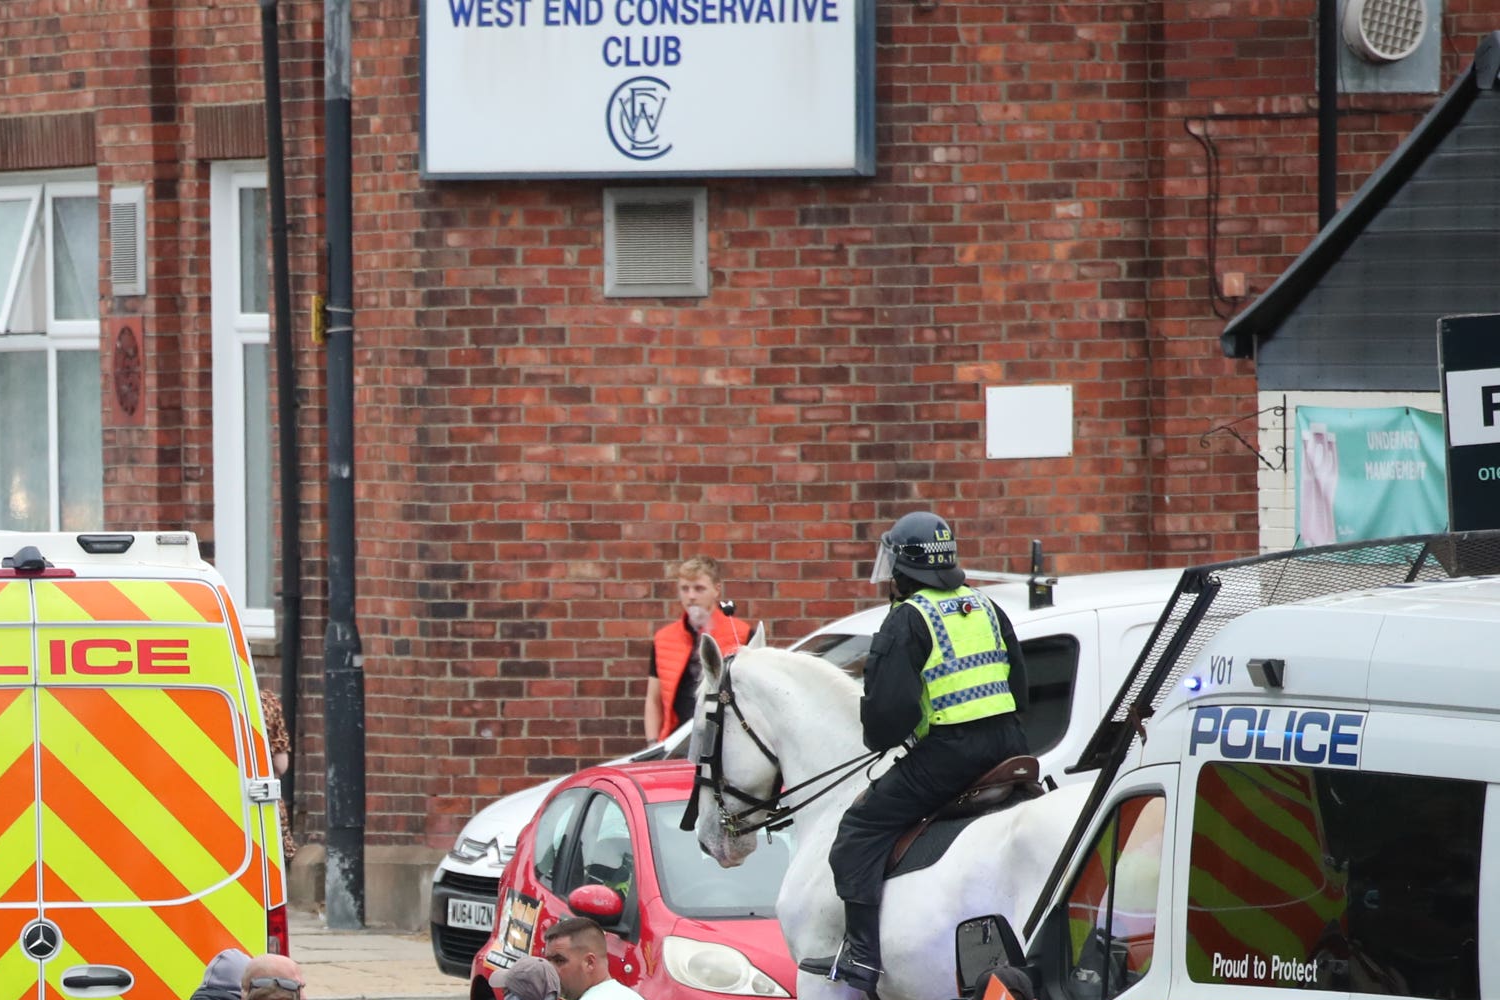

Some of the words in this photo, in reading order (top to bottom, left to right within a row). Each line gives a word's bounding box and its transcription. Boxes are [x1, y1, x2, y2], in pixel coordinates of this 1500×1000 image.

[448, 0, 529, 27] WEST
[544, 0, 604, 26] END
[615, 0, 839, 26] CONSERVATIVE
[602, 36, 681, 67] CLUB
[935, 530, 950, 541] LB
[1210, 656, 1233, 685] Y01
[1189, 706, 1364, 766] POLICE
[1212, 952, 1249, 978] Proud
[1254, 955, 1266, 979] to
[1271, 955, 1317, 982] Protect
